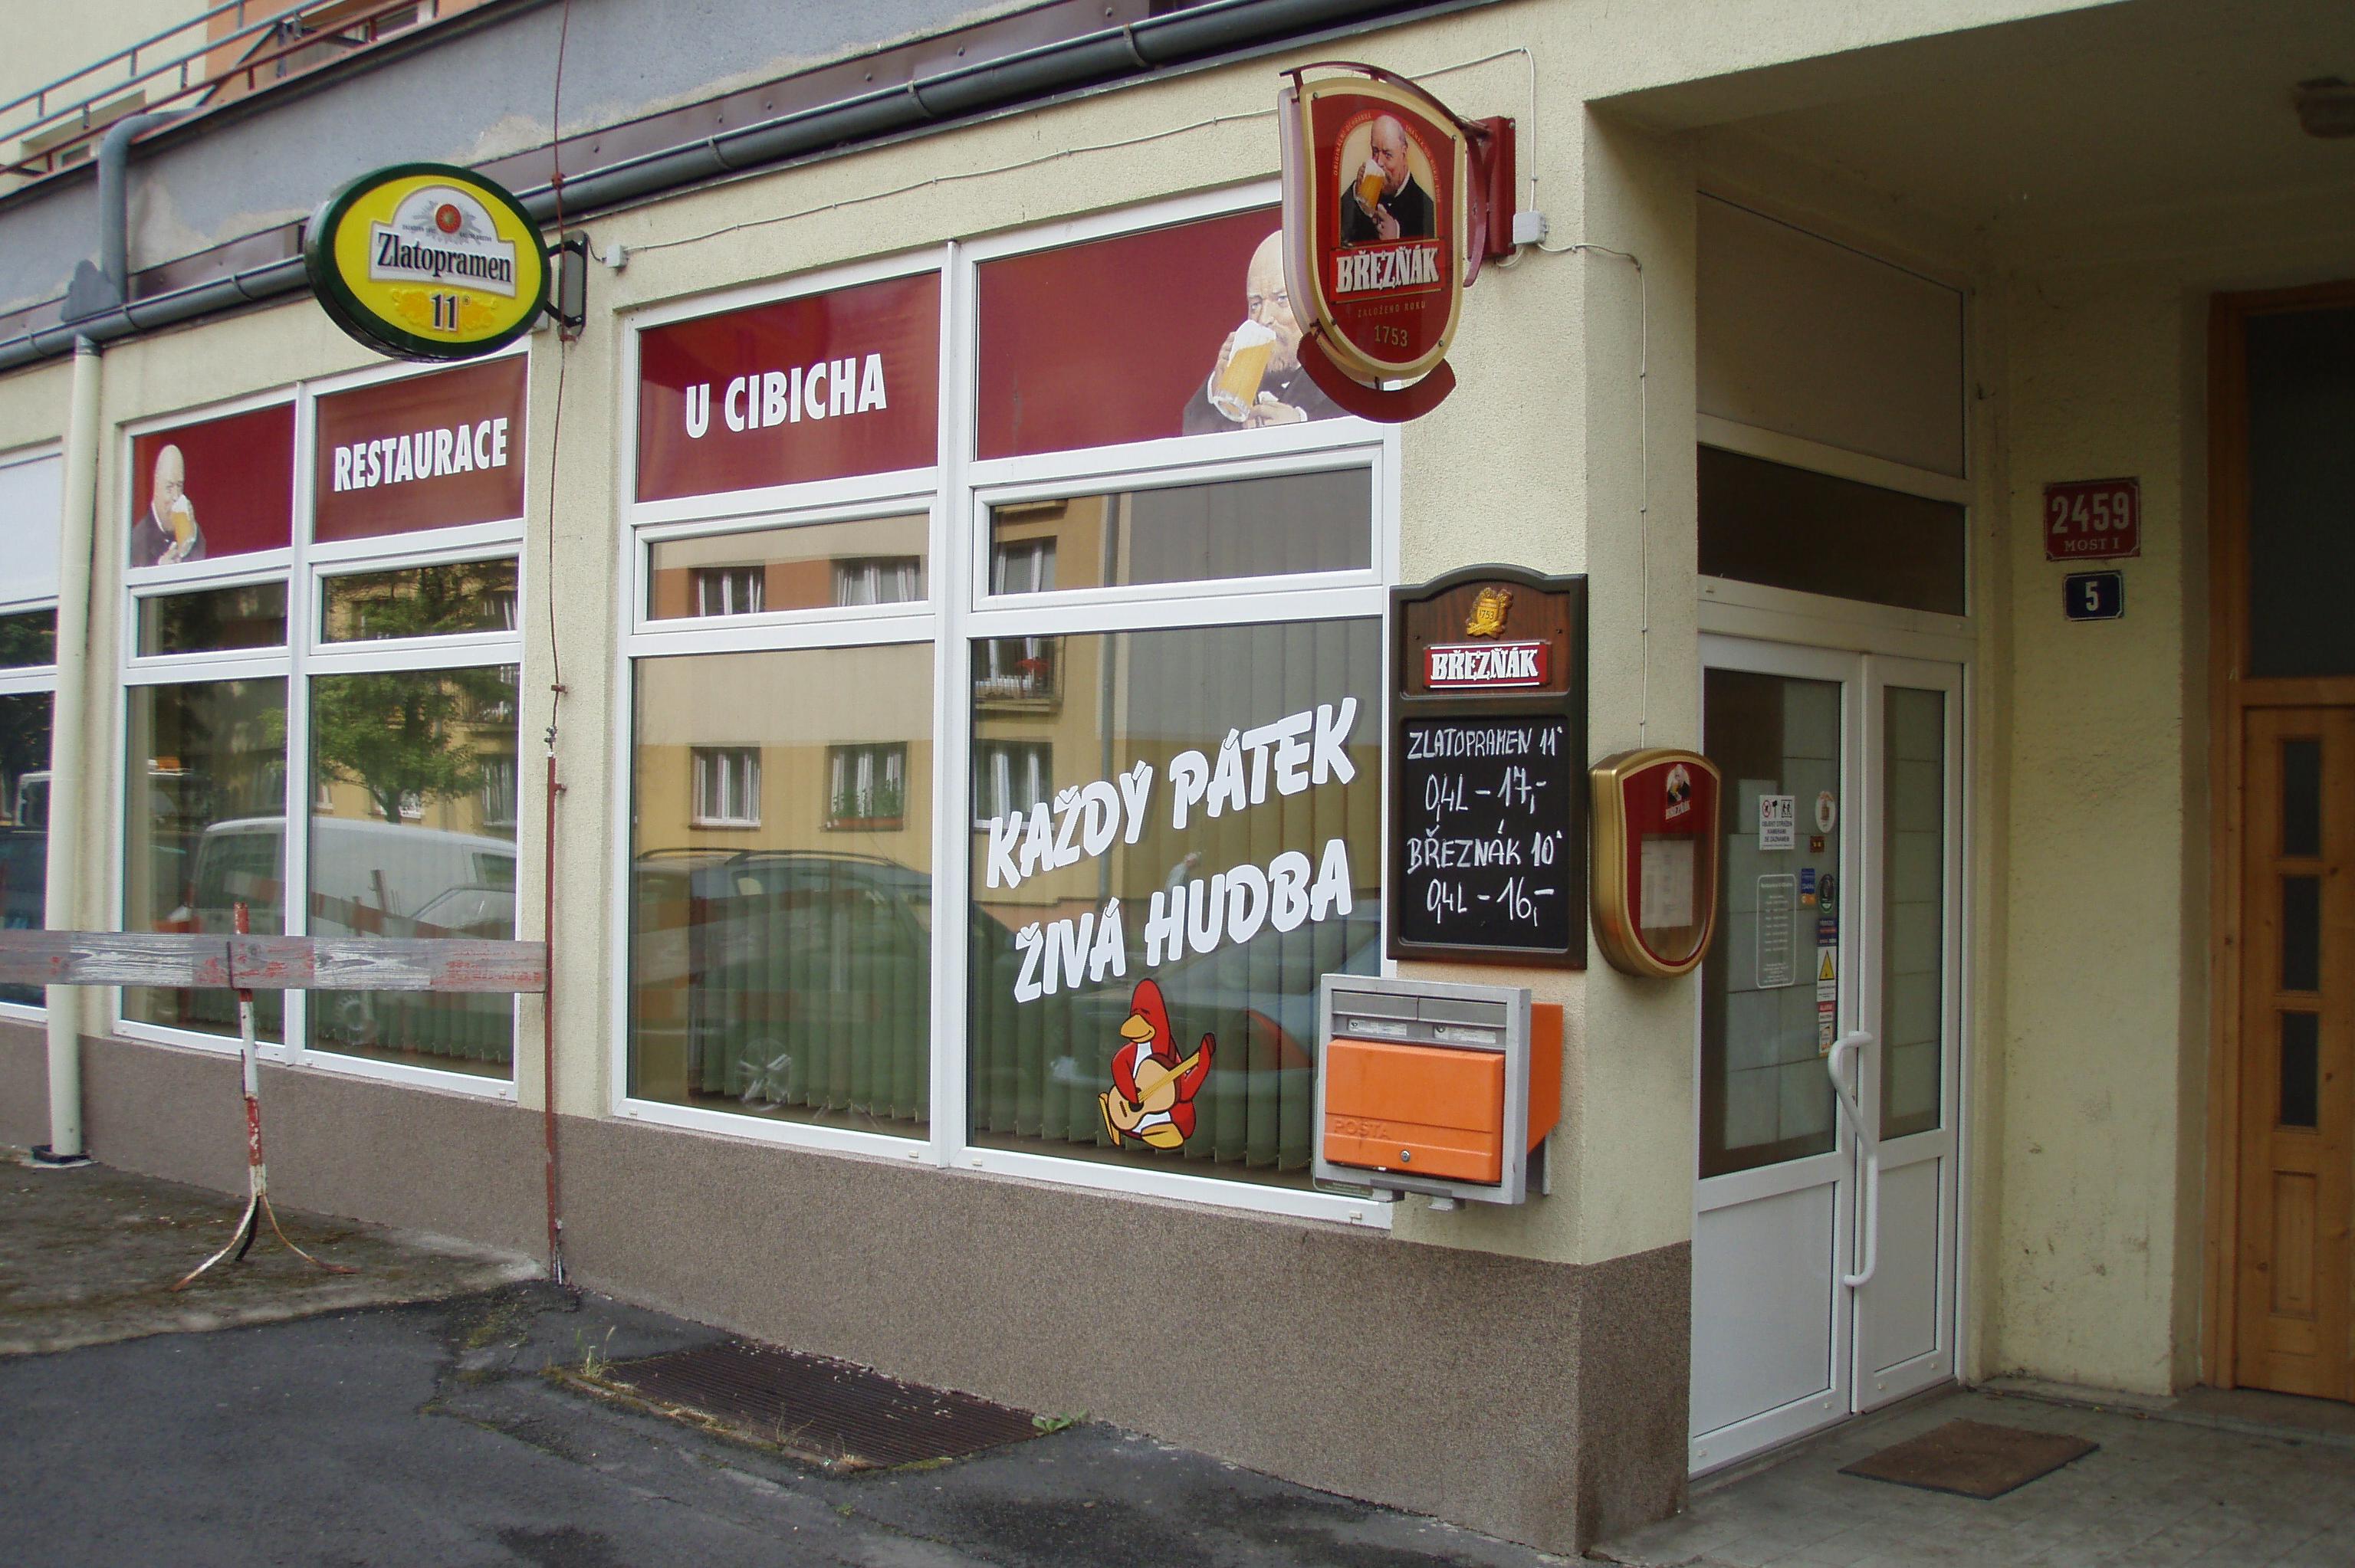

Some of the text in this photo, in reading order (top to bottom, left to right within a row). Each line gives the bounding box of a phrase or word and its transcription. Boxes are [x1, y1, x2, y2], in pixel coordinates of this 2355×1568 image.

[377, 231, 512, 283] Zlatopramen
[1335, 244, 1440, 293] BŘEZŇÁK
[1358, 300, 1426, 318] ZALOŽENO ROKU
[1374, 325, 1408, 347] 1753
[686, 353, 888, 438] U CIBICHA
[333, 417, 508, 493] RESTAURACE
[2051, 491, 2130, 534] 2459
[2064, 537, 2120, 552] MOST I
[1479, 609, 1495, 620] 1753
[2084, 581, 2099, 612] 5
[1430, 648, 1539, 681] BŘEZŇÁK
[1406, 728, 1532, 759] ZLATOPRAMEN
[987, 697, 1357, 889] KAŽDÝ PÁTEK
[1407, 818, 1521, 874] BŘEZNÁK
[1014, 839, 1352, 1003] ŽIVÁ HUDBA
